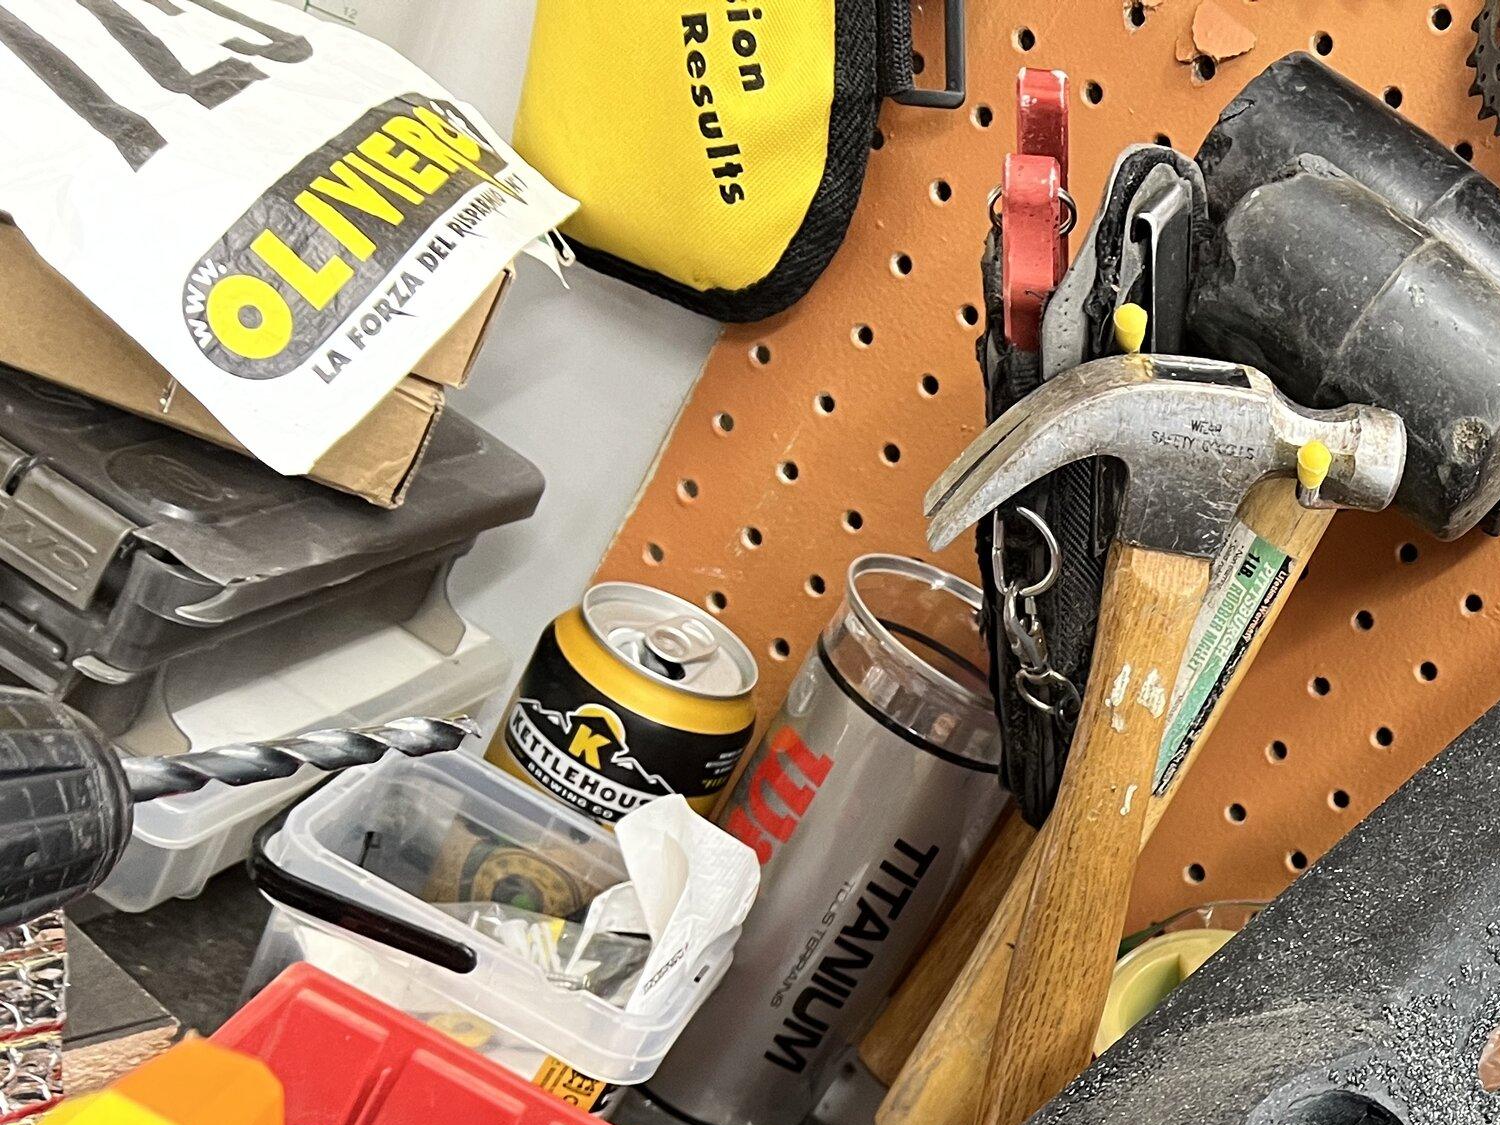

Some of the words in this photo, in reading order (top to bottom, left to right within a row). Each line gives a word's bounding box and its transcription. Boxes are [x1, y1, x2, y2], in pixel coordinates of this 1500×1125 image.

[727, 0, 766, 92] ion
[681, 12, 745, 206] Results
[311, 349, 350, 384] LA
[348, 270, 426, 352] FORZA
[415, 228, 456, 273] DEL
[1187, 629, 1218, 671] MALLET
[1210, 582, 1244, 635] RUBBER
[1216, 562, 1277, 661] PITTSBURGH
[509, 709, 652, 814] KETTLEHOU
[523, 761, 590, 809] BREWING
[570, 726, 609, 769] K
[764, 837, 940, 1072] TITANIUM
